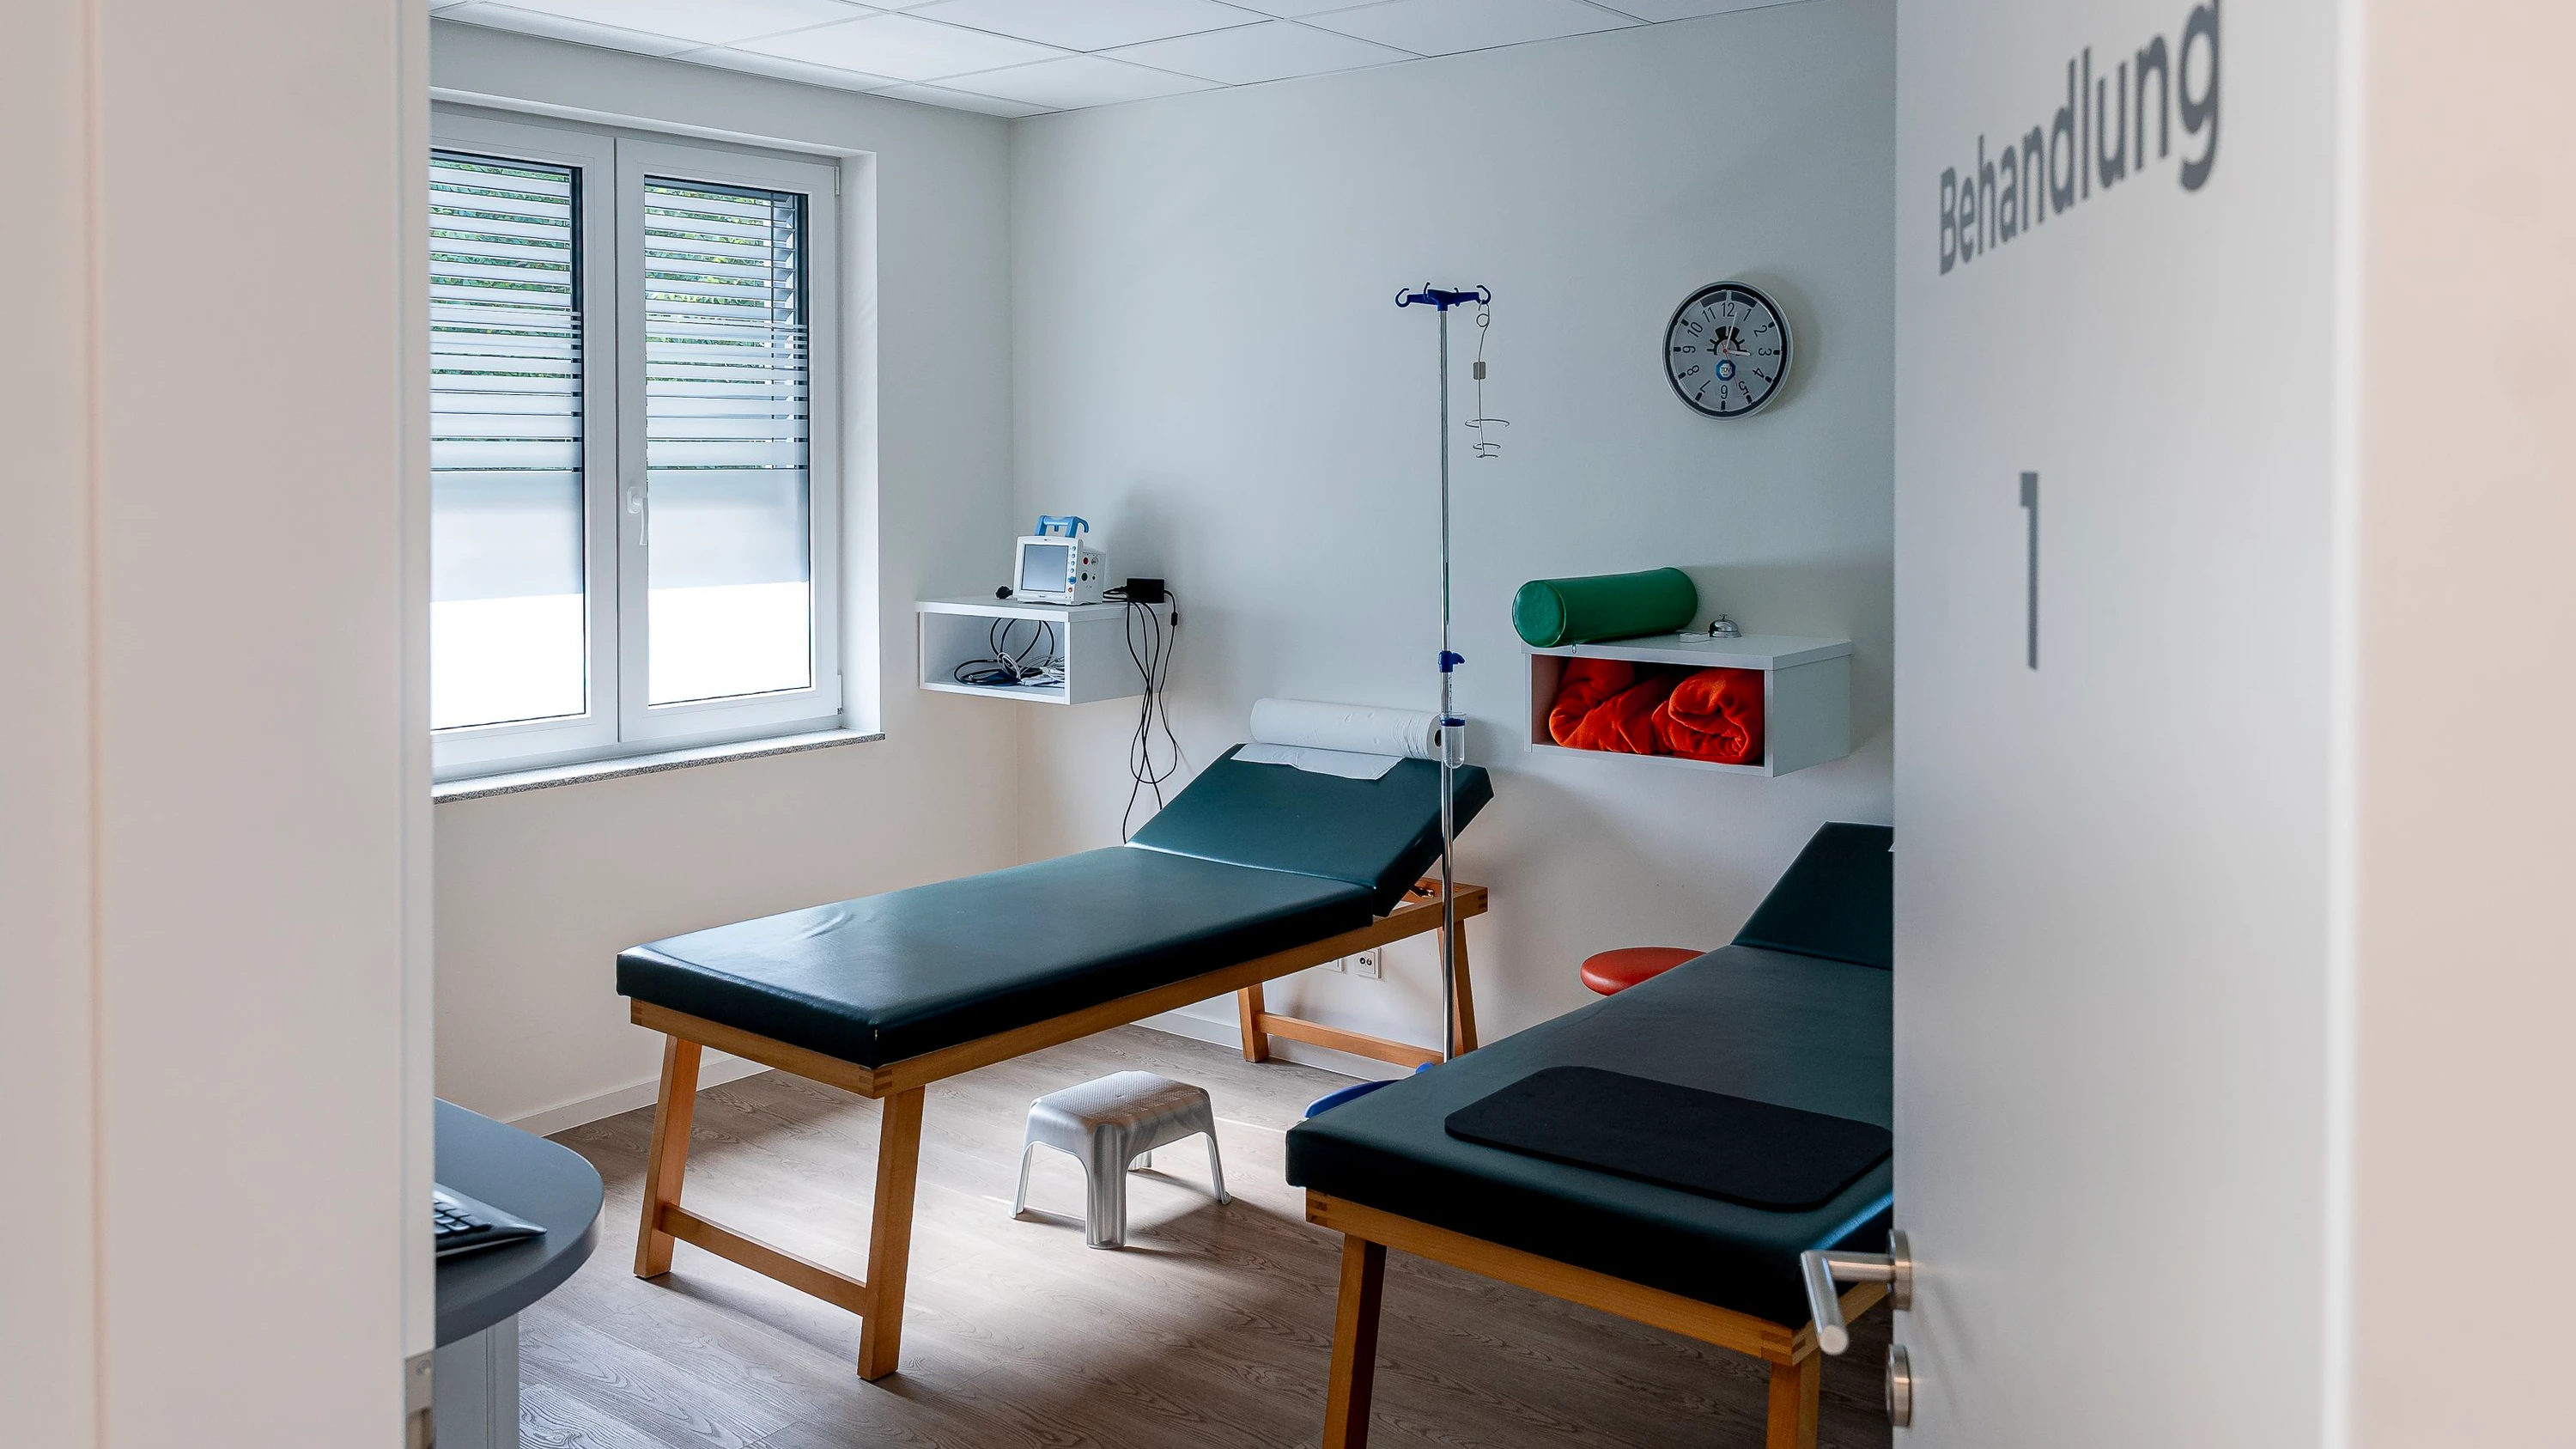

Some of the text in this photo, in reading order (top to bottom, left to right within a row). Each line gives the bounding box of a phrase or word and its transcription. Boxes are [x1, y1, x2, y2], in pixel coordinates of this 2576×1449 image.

[1939, 0, 2220, 276] Behandlung
[1702, 307, 1716, 323] 11
[1721, 302, 1735, 317] 12
[1743, 308, 1753, 322] 1
[1687, 321, 1704, 338] 10
[1753, 325, 1768, 338] 2
[1682, 345, 1696, 354] 9
[1758, 348, 1772, 356] 3
[1686, 364, 1700, 376] 8
[1752, 368, 1765, 380] 4
[1699, 380, 1710, 393] 7
[1738, 381, 1749, 396] 5
[2020, 472, 2038, 670] 1
